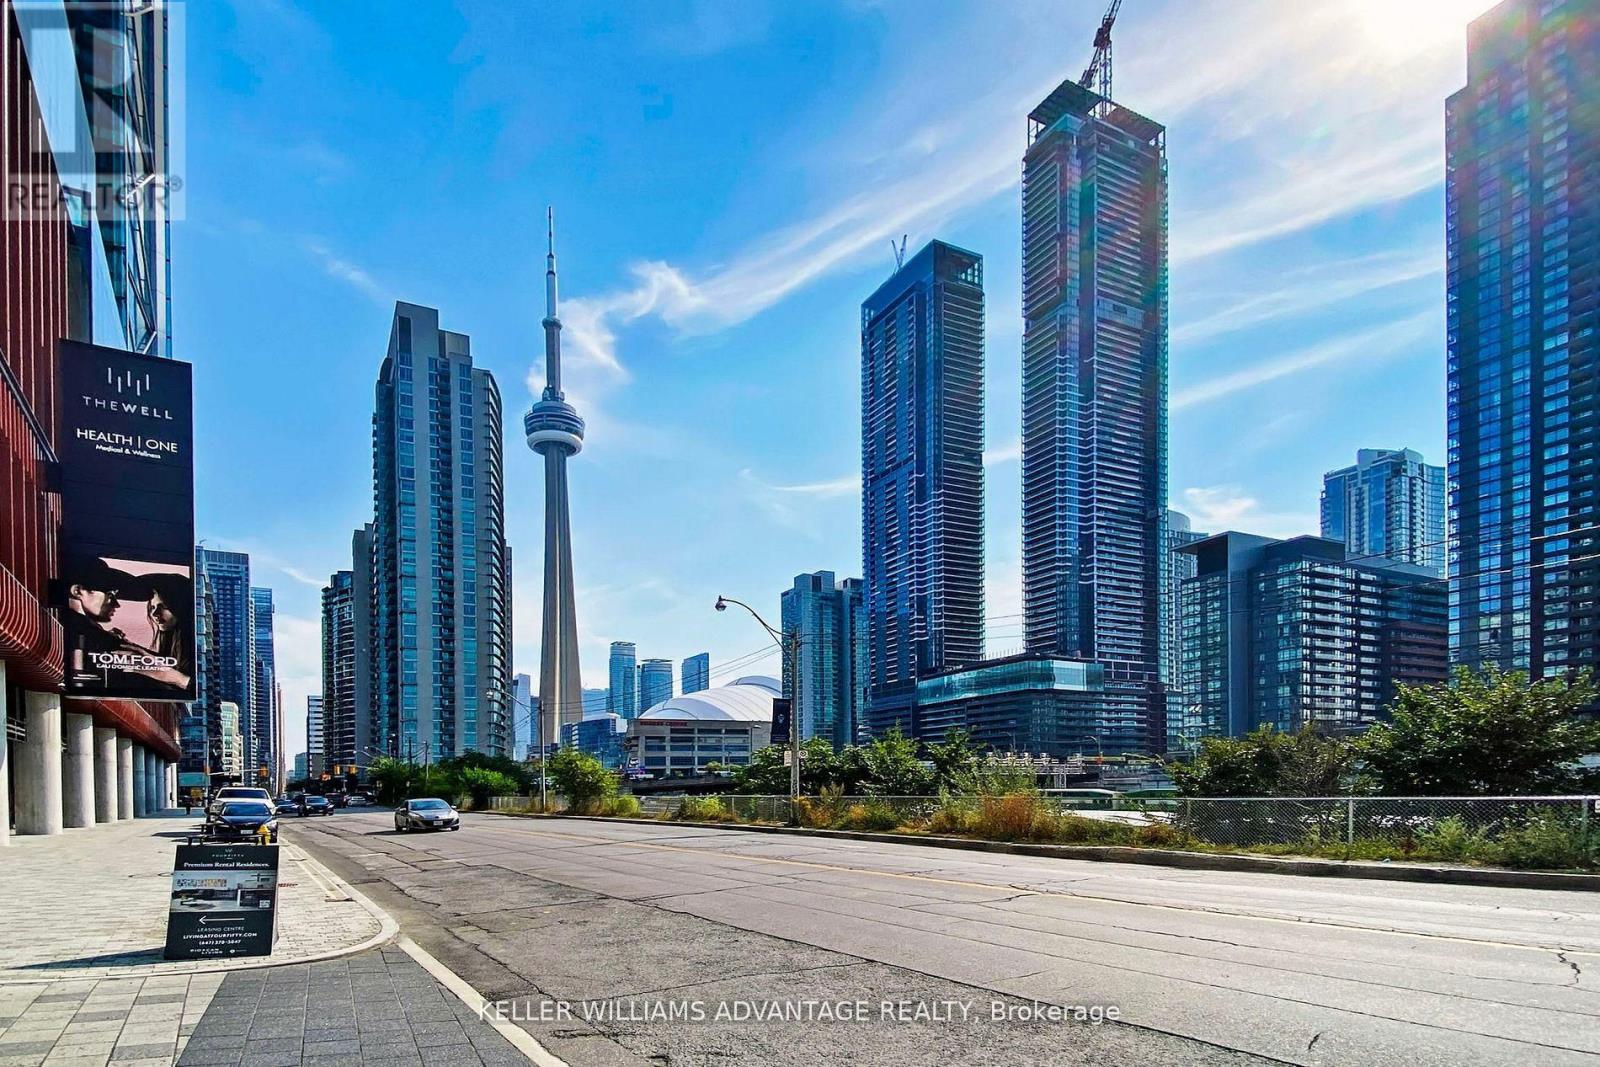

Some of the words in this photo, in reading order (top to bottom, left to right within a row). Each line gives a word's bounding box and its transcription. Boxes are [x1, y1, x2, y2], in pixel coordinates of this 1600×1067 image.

[76, 427, 133, 446] HEALTH
[145, 439, 178, 453] ONE
[95, 444, 123, 454] Medical
[132, 449, 161, 459] Wellness
[88, 652, 127, 664] TOM
[131, 655, 178, 667] FORD
